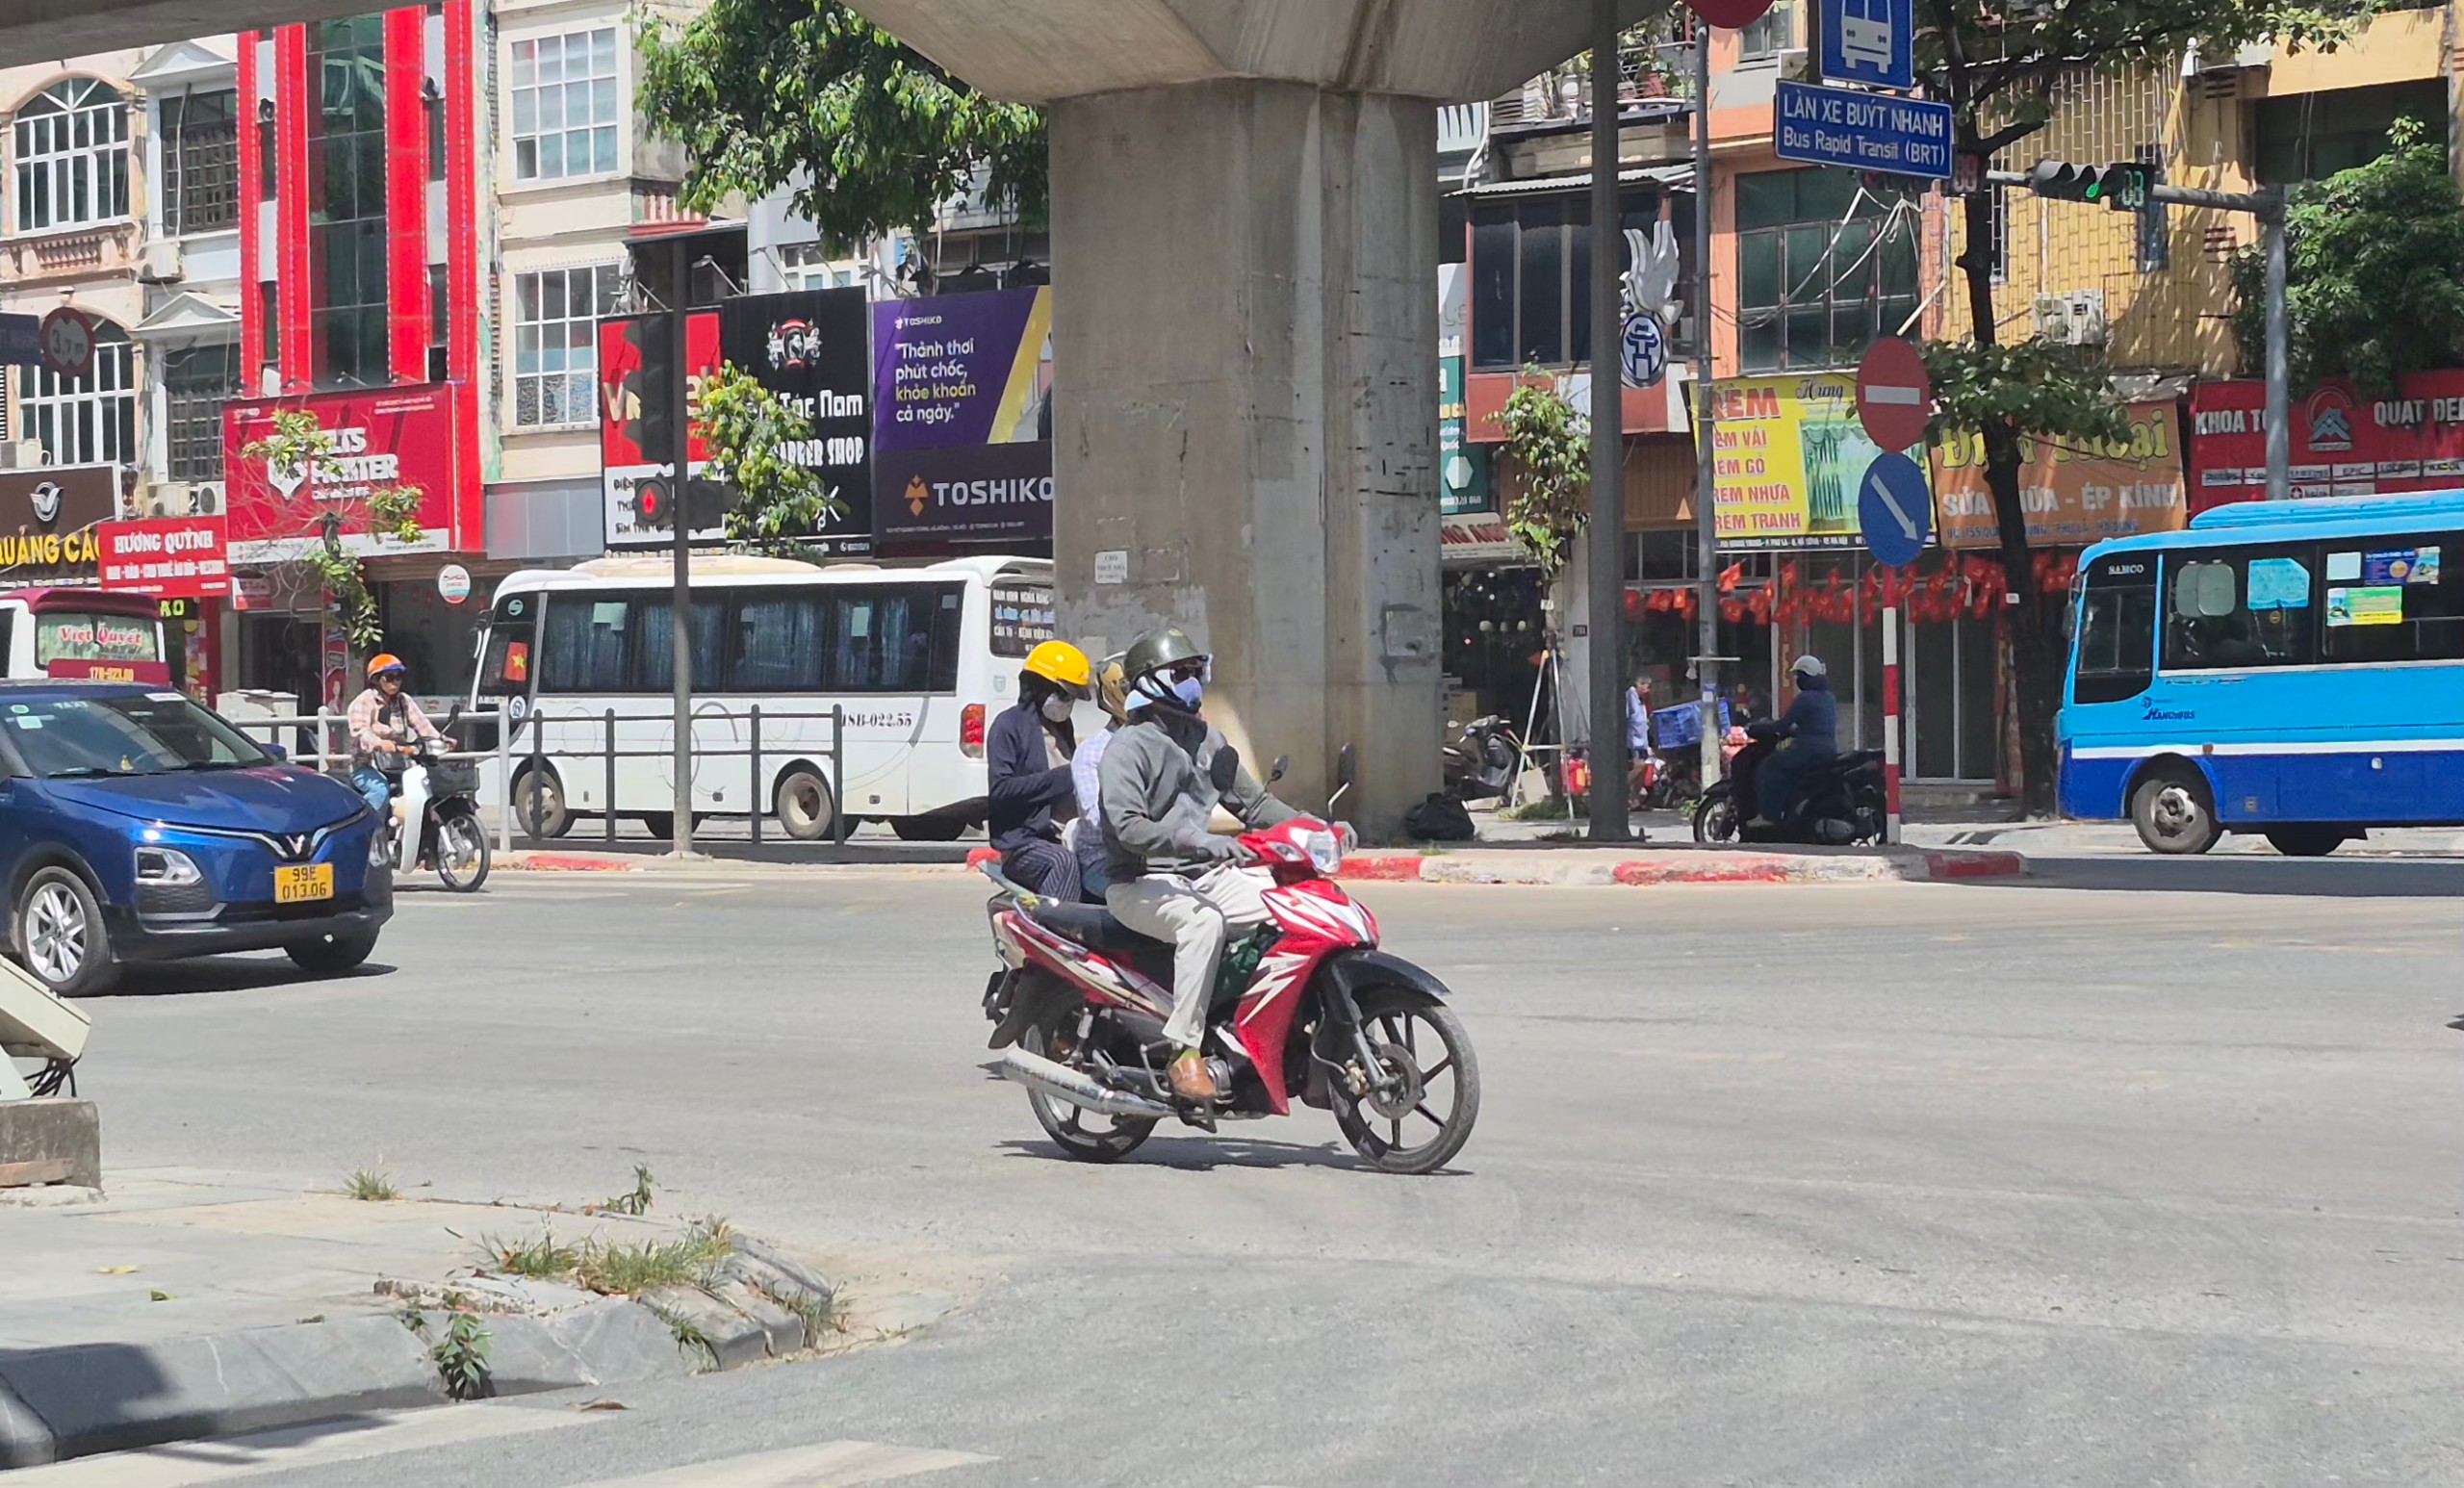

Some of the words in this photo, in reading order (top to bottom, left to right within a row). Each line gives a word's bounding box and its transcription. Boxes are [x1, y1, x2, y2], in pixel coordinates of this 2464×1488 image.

[1784, 90, 1817, 120] LÀN
[1822, 99, 1843, 124] XE
[1846, 97, 1886, 129] BUÝT
[1891, 108, 1943, 138] NHANH
[1784, 125, 1810, 148] Bus
[1815, 129, 1852, 158] Rapid
[1856, 134, 1899, 161] Transit
[1905, 140, 1945, 167] (BRT)
[895, 362, 928, 384] phút
[819, 389, 864, 418] Nam
[2374, 398, 2425, 430] QUẠT
[827, 436, 865, 466] SHOP
[933, 476, 1054, 507] TOSHIKO
[1942, 485, 1992, 518] SỬA
[2081, 482, 2113, 511] ÉP
[2118, 481, 2179, 509] KÍNH
[1751, 512, 1801, 529] TRANH
[0, 525, 60, 565] UẢNG
[2108, 564, 2145, 576] SAMCO
[282, 882, 327, 901] 013.06
